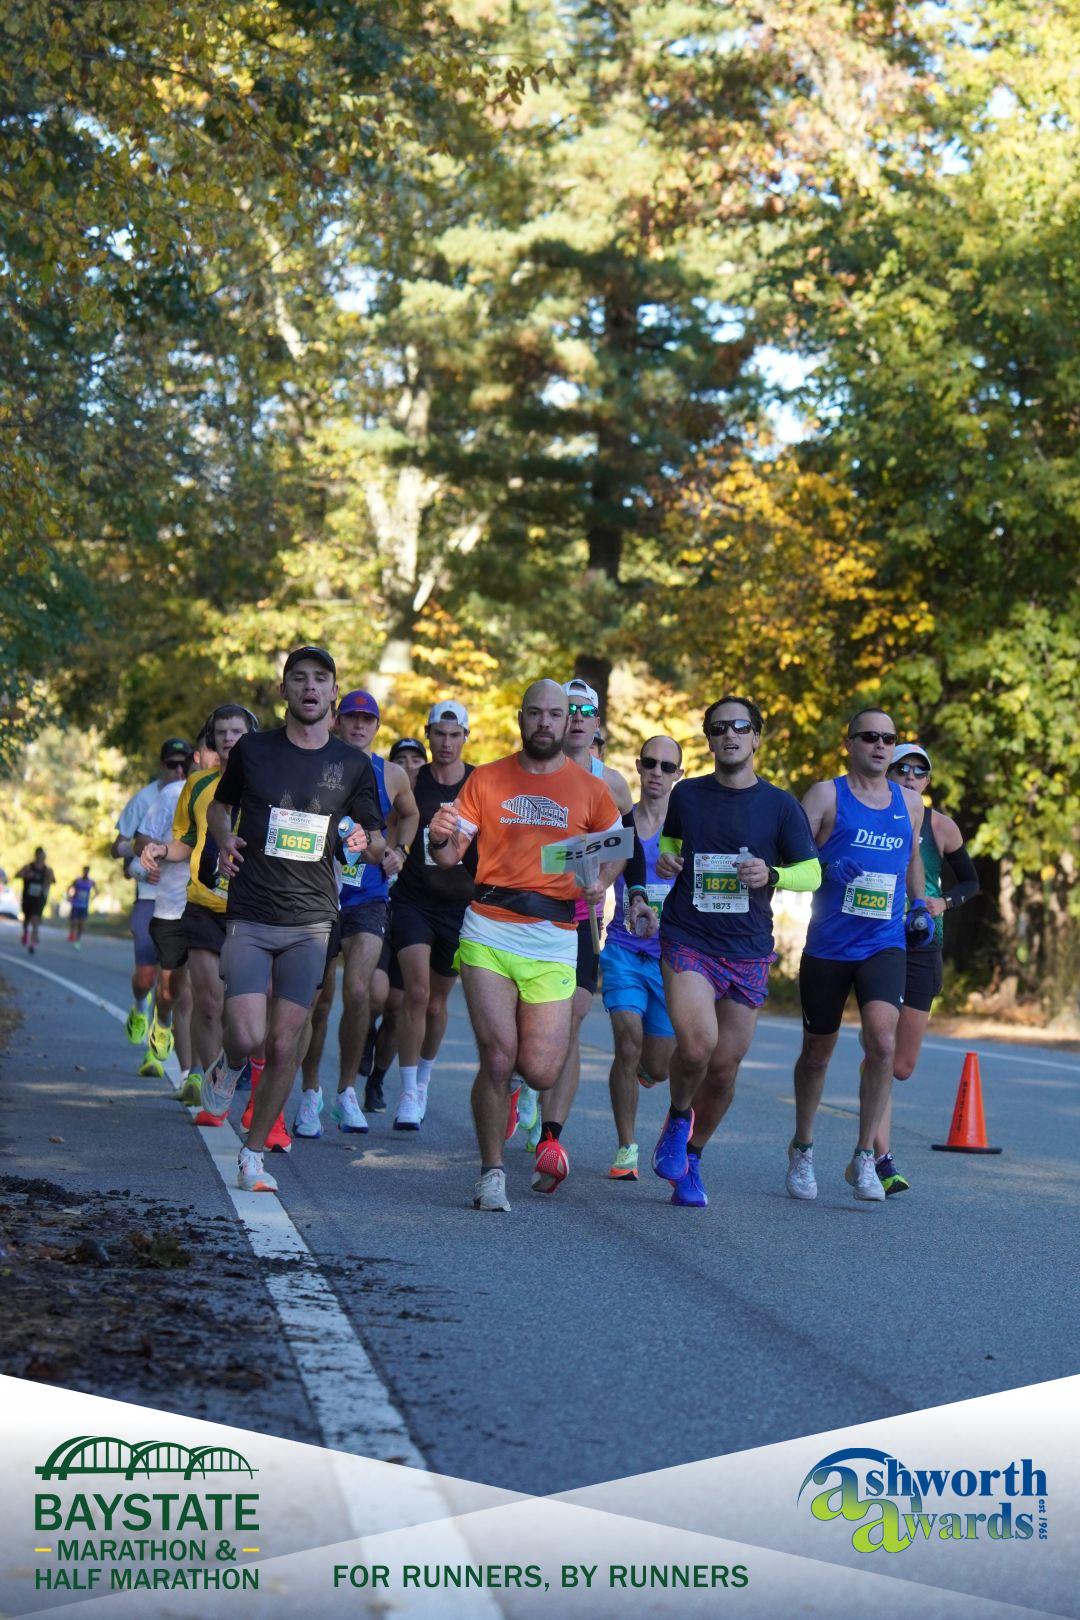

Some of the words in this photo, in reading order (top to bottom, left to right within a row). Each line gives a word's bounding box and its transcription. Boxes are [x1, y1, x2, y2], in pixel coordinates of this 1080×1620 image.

[281, 834, 312, 850] 1615
[854, 828, 904, 850] Dirigo
[705, 878, 737, 891] 1873
[712, 902, 732, 910] 1873
[856, 893, 886, 909] 1220
